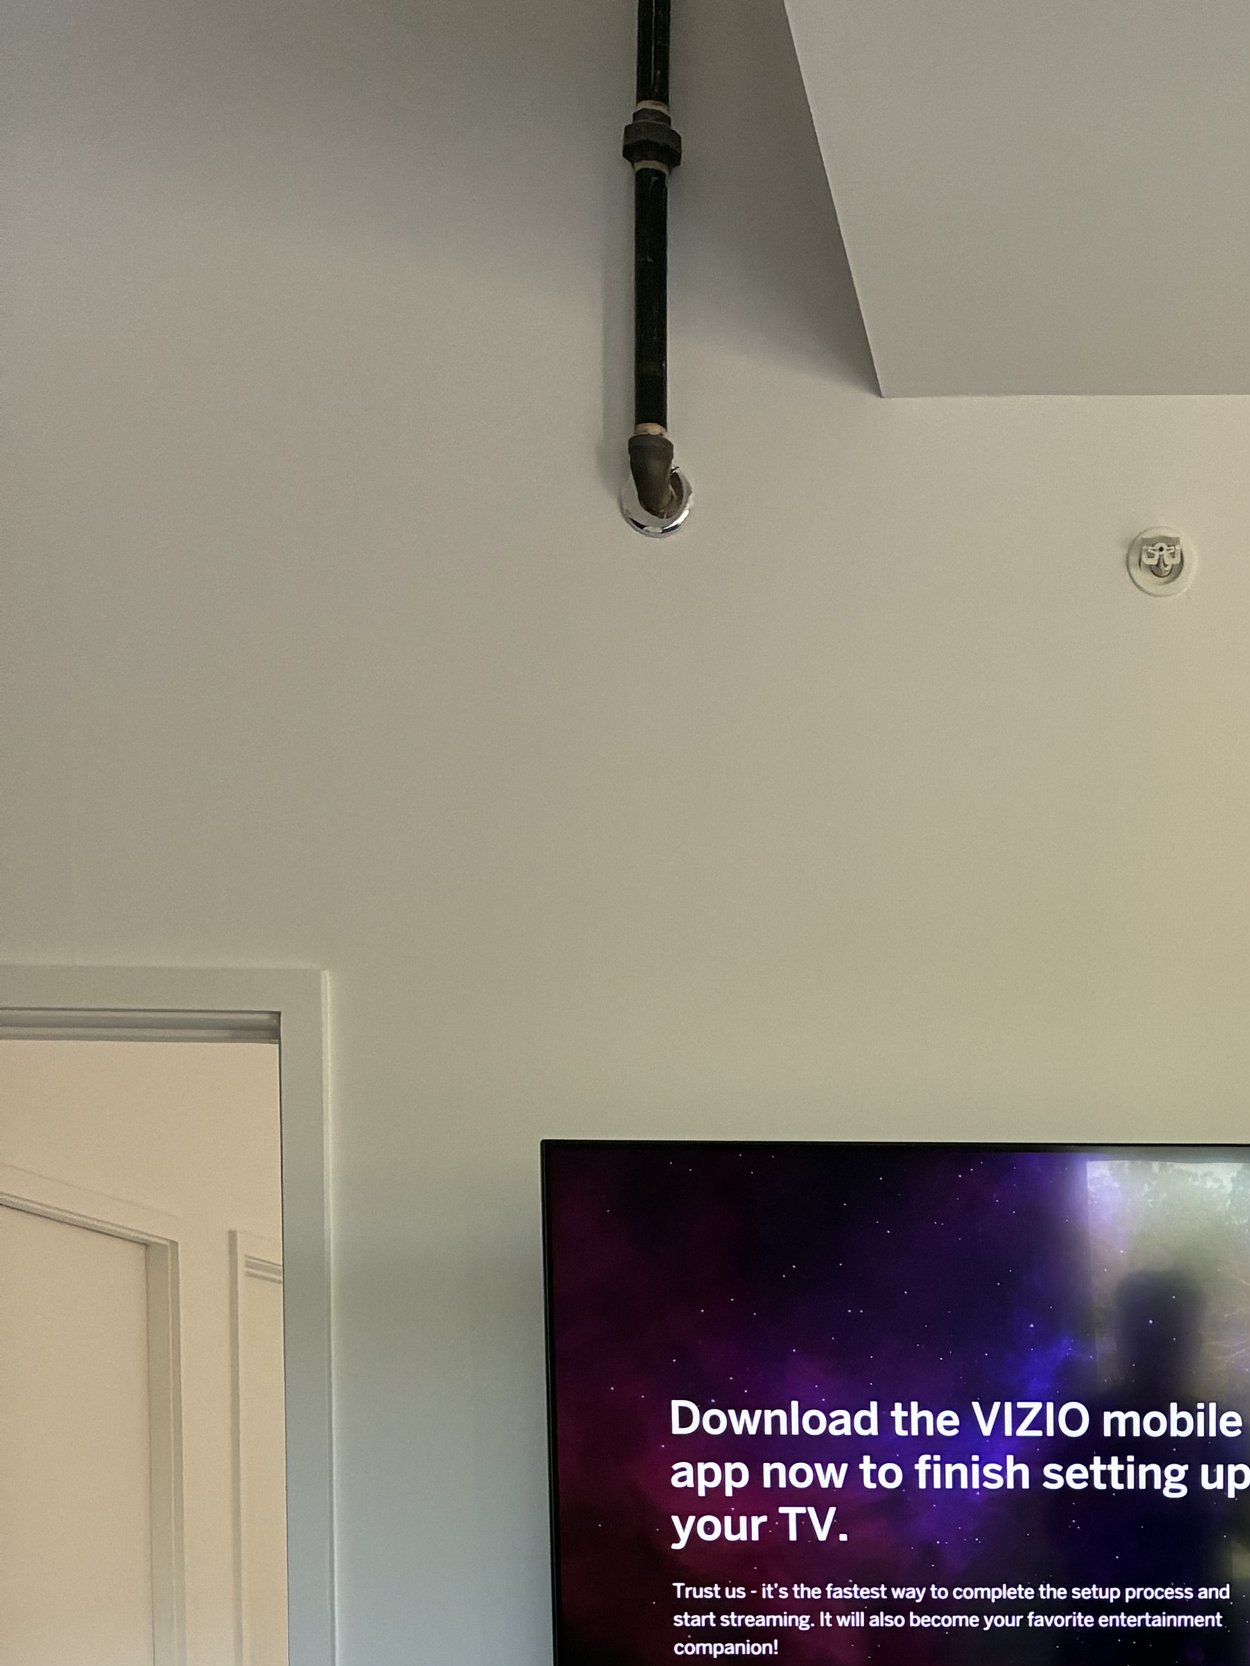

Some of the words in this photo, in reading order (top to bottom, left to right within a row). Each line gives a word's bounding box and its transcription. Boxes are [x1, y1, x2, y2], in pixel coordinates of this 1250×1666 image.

[671, 1399, 878, 1436] Download
[891, 1401, 959, 1436] the
[972, 1402, 1089, 1437] VIZIO
[1104, 1402, 1242, 1437] mobile
[671, 1462, 749, 1496] app
[763, 1462, 848, 1488] now
[859, 1455, 903, 1489] to
[915, 1455, 1029, 1489] finish
[1043, 1455, 1188, 1498] setting
[1201, 1464, 1250, 1498] up
[671, 1515, 767, 1549] your
[778, 1507, 847, 1542] TV.
[672, 1583, 721, 1598] Trust
[725, 1587, 746, 1598] us
[762, 1583, 788, 1598] it's
[792, 1583, 821, 1599] the
[826, 1583, 887, 1599] fastest
[891, 1587, 926, 1602] way
[930, 1584, 948, 1599] to
[953, 1584, 1034, 1603] complete
[1039, 1584, 1067, 1599] the
[1072, 1584, 1120, 1603] setup
[1125, 1584, 1193, 1603] process
[1198, 1584, 1231, 1602] and
[674, 1612, 716, 1626] start
[720, 1612, 814, 1630] streaming.
[820, 1611, 832, 1627] It
[836, 1612, 864, 1626] will
[869, 1611, 905, 1627] also
[910, 1612, 979, 1627] become
[983, 1615, 1023, 1630] your
[1027, 1612, 1094, 1627] favorite
[1098, 1612, 1222, 1627] entertainment
[674, 1639, 778, 1658] companion!
